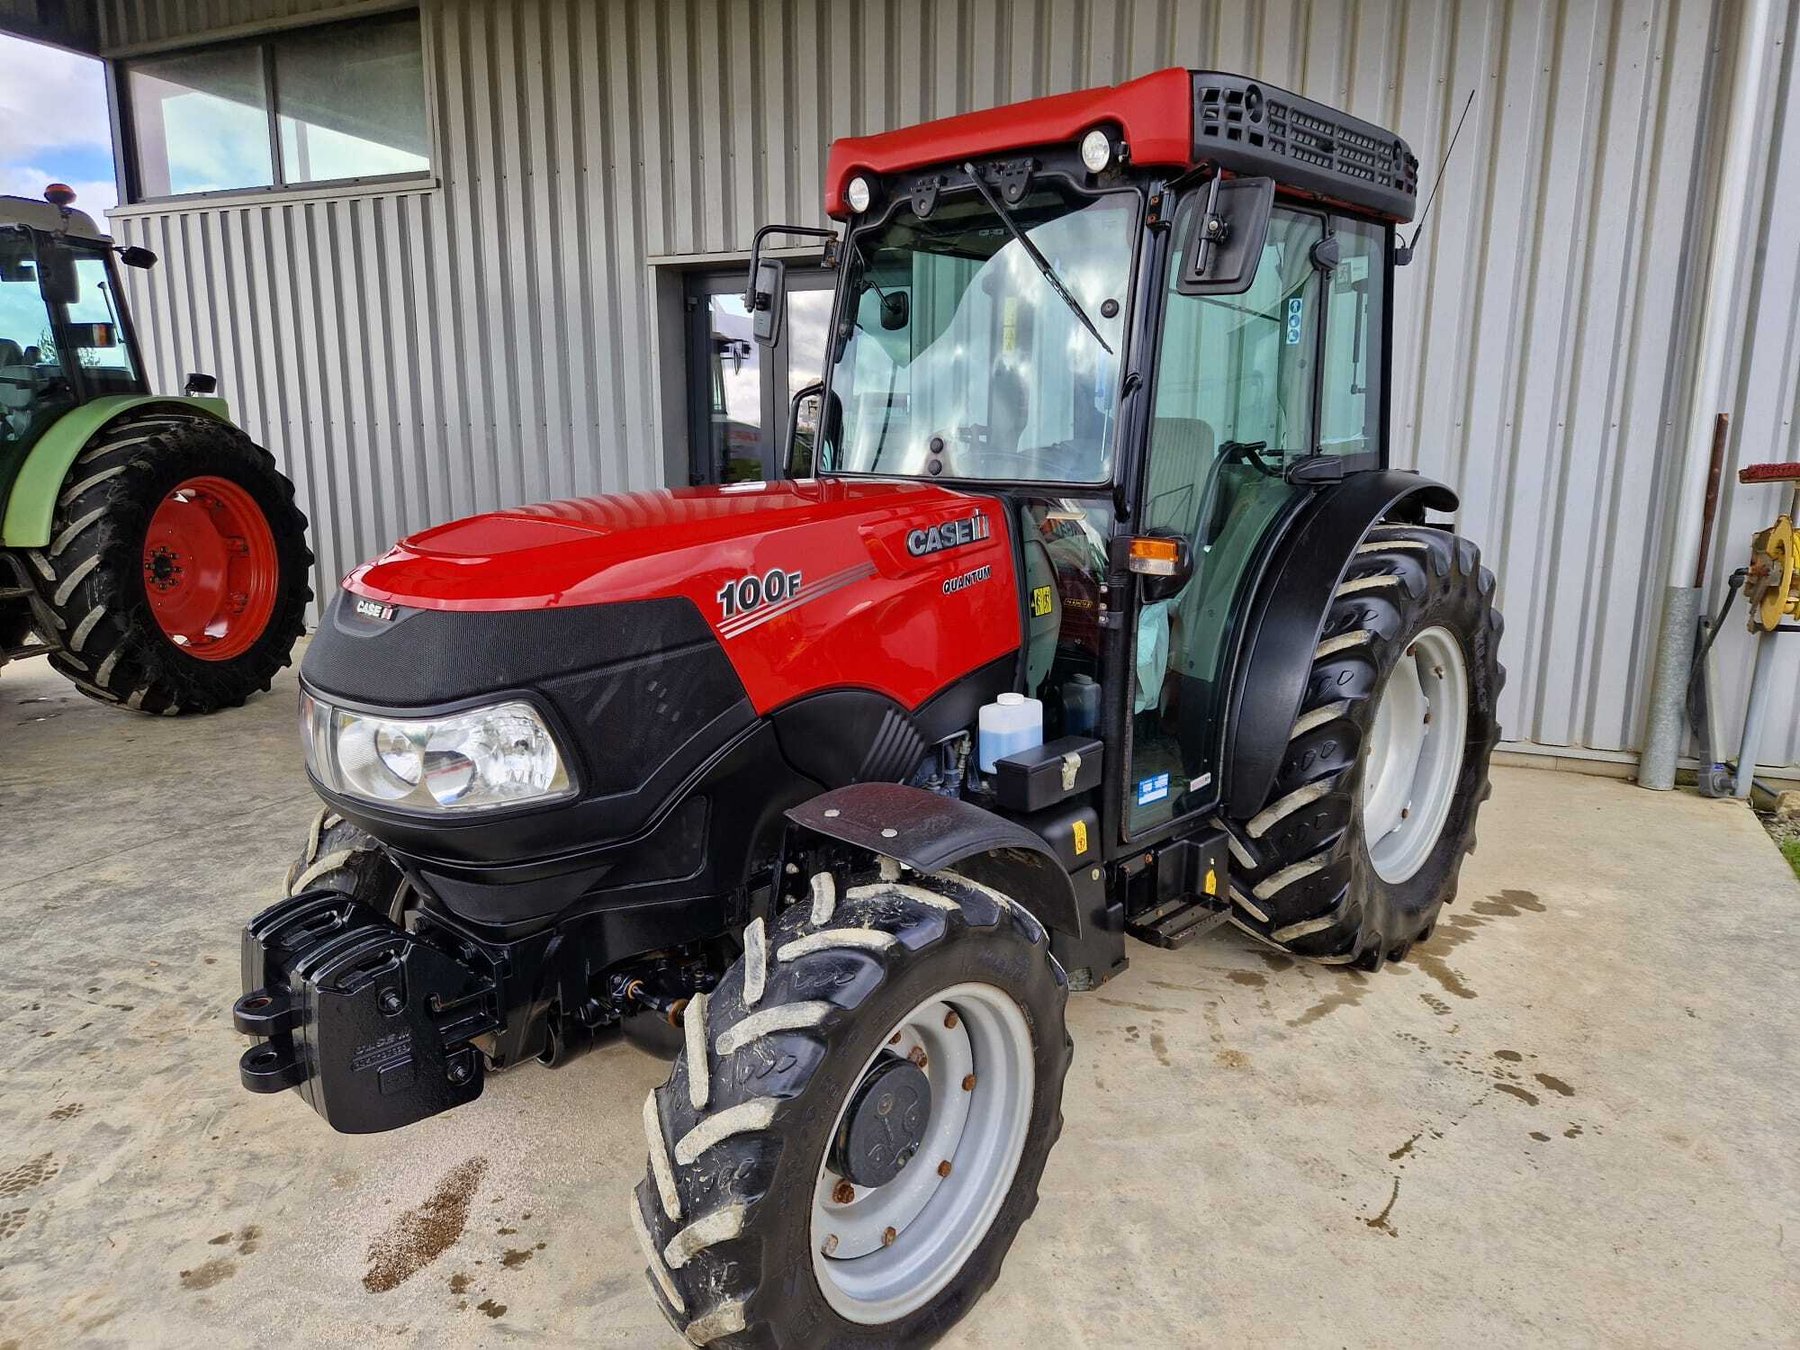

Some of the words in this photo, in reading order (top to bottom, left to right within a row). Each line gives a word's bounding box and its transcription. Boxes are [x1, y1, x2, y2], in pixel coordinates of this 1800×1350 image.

[906, 519, 971, 557] CASE
[716, 567, 802, 619] 100F
[942, 565, 991, 595] QUANTUM
[356, 600, 382, 617] CASE
